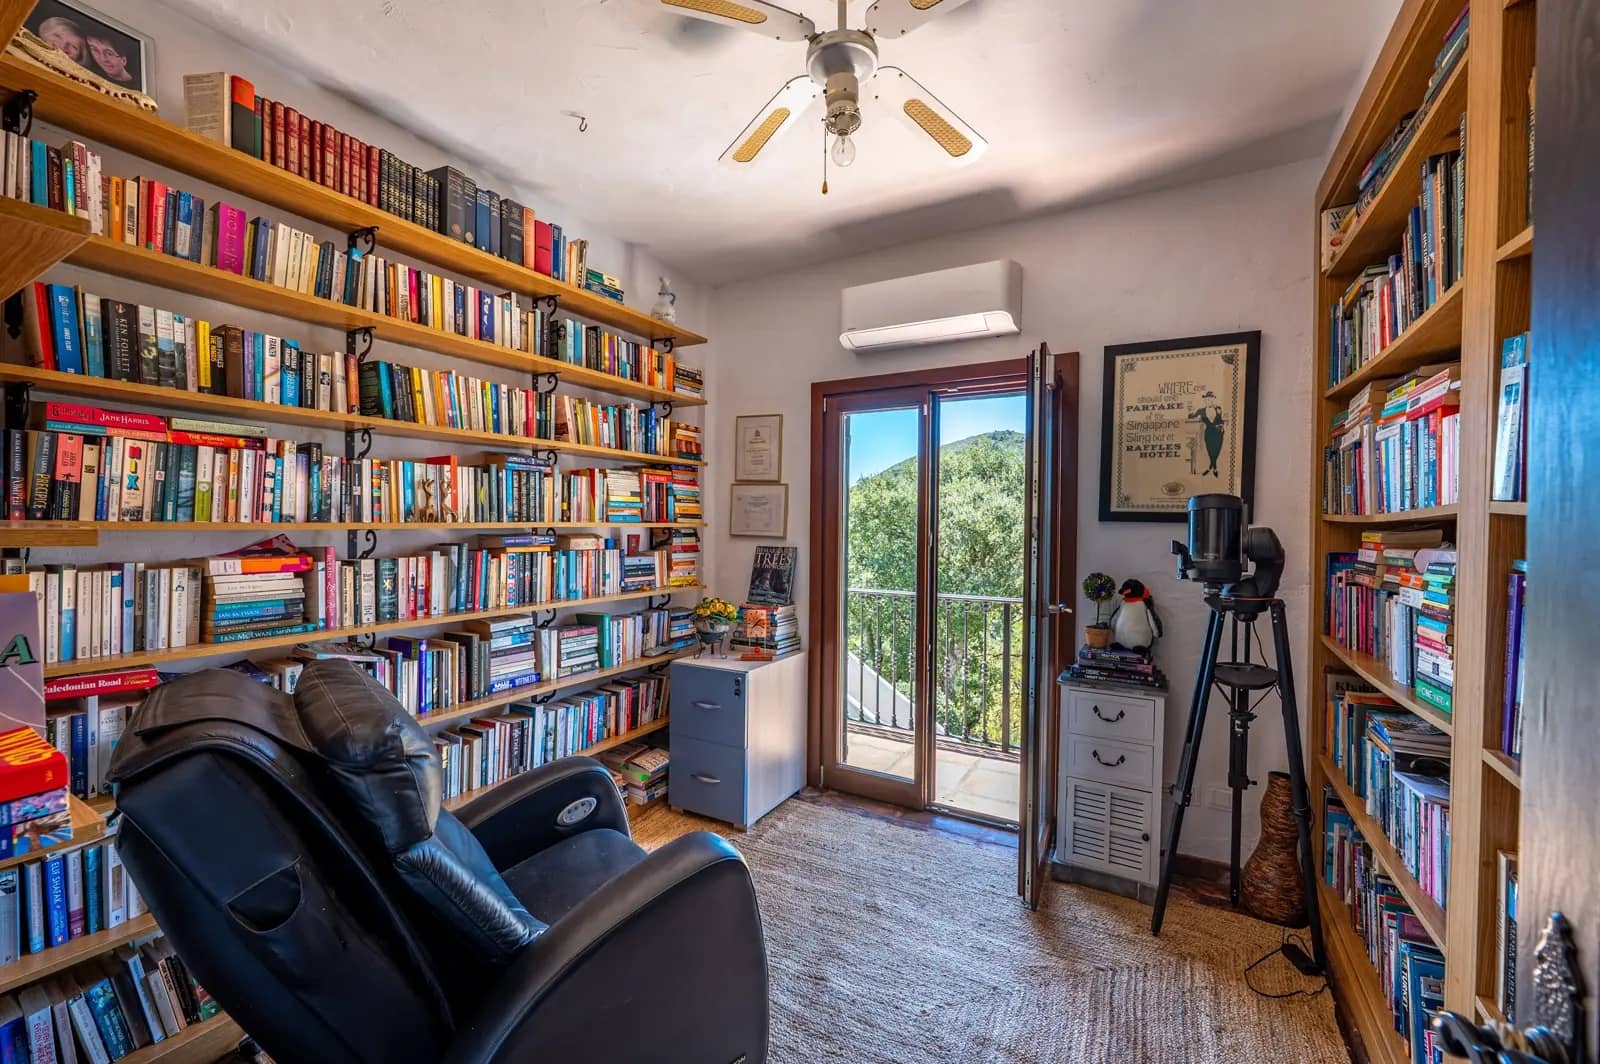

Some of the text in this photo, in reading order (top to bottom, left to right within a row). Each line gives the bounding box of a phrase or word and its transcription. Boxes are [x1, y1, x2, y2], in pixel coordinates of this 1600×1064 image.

[119, 318, 130, 373] KEN FOLLETT
[1158, 381, 1194, 394] WHERE
[1126, 402, 1185, 412] PARTAKE
[1126, 420, 1181, 432] Singapore
[1126, 432, 1152, 445] Sling
[1126, 443, 1182, 452] RAFFLES
[1139, 450, 1181, 458] HOTEL
[33, 473, 51, 509] PRECIPICE
[756, 552, 792, 566] TREES
[99, 678, 122, 688] Road
[1401, 970, 1409, 1011] TURKEY
